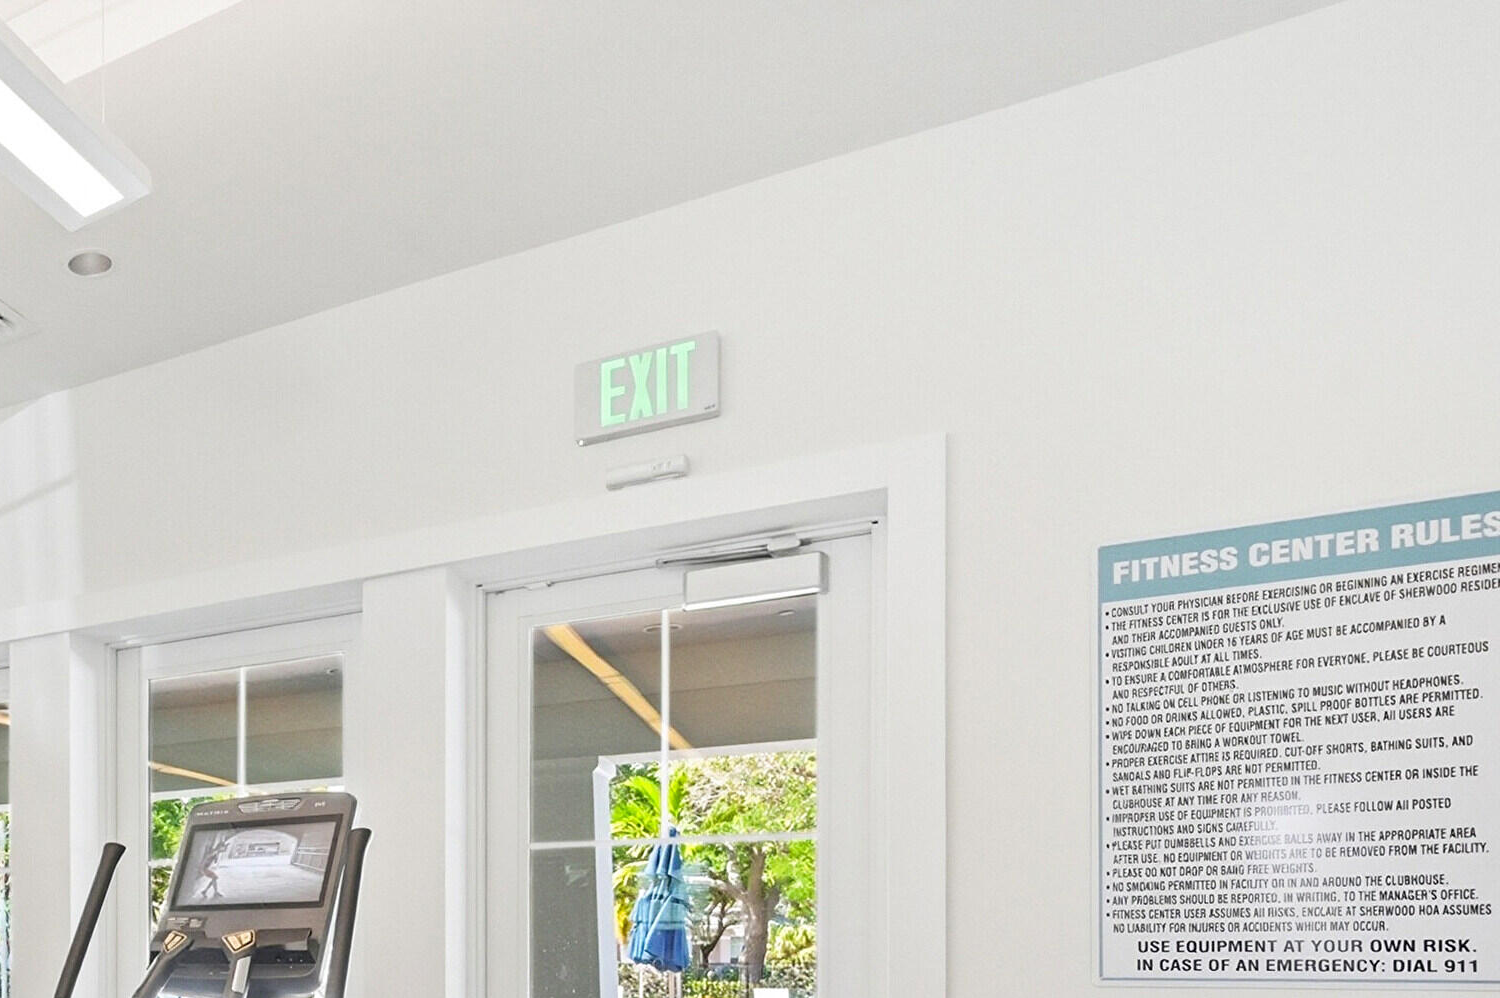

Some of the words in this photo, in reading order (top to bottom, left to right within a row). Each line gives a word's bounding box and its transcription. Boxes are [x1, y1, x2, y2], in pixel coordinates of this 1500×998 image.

[601, 341, 695, 427] EXIT
[1113, 546, 1238, 584] FITNESS
[1249, 528, 1379, 567] CENTER
[1391, 511, 1500, 549] RULES
[1177, 595, 1223, 610] PHYSICIAN
[1318, 582, 1332, 593] OR
[1335, 575, 1387, 592] BEGINNING
[1390, 573, 1404, 585] AN
[1406, 567, 1454, 583] EXERCISE
[1165, 612, 1198, 625] CENTER
[1201, 610, 1210, 621] IS
[1212, 608, 1230, 620] FOR
[1232, 606, 1248, 618] THE
[1302, 598, 1321, 610] USE
[1324, 596, 1336, 608] OF
[1338, 591, 1380, 606] ENCLAVE
[1383, 589, 1396, 601] OF
[1398, 582, 1457, 599] SHERWOOD
[1111, 633, 1129, 645] AND
[1131, 631, 1156, 643] THEIR
[1158, 623, 1220, 640] ACCOMPANIED
[1222, 619, 1257, 633] GUESTS
[1194, 637, 1224, 650] UNDER
[1238, 633, 1268, 646] YEARS
[1284, 629, 1304, 641] AGE
[1306, 626, 1332, 639] MUST
[1335, 624, 1347, 636] BE
[1349, 617, 1420, 634] ACCOMPANIED
[1422, 615, 1436, 627] BY
[1438, 614, 1446, 625] A
[1159, 671, 1166, 681] A
[1295, 657, 1315, 669] FOR
[1372, 648, 1409, 662] PLEASE
[1411, 647, 1424, 658] BE
[1426, 641, 1488, 657] COURTEOUS
[1171, 654, 1198, 666] ADULT
[1200, 653, 1211, 664] AT
[1212, 651, 1230, 662] ALL
[1112, 689, 1129, 700] AND
[1187, 682, 1198, 693] OF
[1177, 696, 1198, 708] CELL
[1200, 694, 1230, 706] PHONE
[1232, 692, 1245, 703] OR
[1247, 688, 1294, 702] LISTENING
[1297, 687, 1310, 698] TO
[1312, 684, 1343, 697] MUSIC
[1345, 680, 1390, 694] WITHOUT
[1111, 717, 1123, 727] NO
[1125, 715, 1148, 726] FOOD
[1150, 713, 1163, 724] OR
[1291, 701, 1317, 713] SPILL
[1319, 698, 1352, 711] PROOF
[1354, 695, 1396, 708] BOTTLES
[1398, 693, 1418, 705] ARE
[1134, 727, 1161, 739] DOWN
[1188, 724, 1212, 735] PIECE
[1228, 718, 1280, 732] EQUIPMENT
[1282, 717, 1302, 728] FOR
[1304, 715, 1322, 727] THE
[1324, 713, 1348, 725] NEXT
[1398, 707, 1432, 720] USERS
[1434, 705, 1454, 717] ARE
[1147, 754, 1188, 766] EXERCISE
[1284, 745, 1323, 757] CUT-OFF
[1370, 739, 1412, 752] BATHING
[1451, 735, 1473, 747] AND
[1171, 740, 1182, 750] TO
[1214, 737, 1220, 747] A
[1112, 785, 1130, 796] WET
[1170, 781, 1195, 792] SUITS
[1198, 780, 1215, 791] ARE
[1217, 779, 1234, 790] NOT
[1290, 775, 1300, 786] IN
[1302, 774, 1321, 785] THE
[1323, 772, 1362, 784] FITNESS
[1364, 770, 1402, 782] CENTER
[1404, 769, 1419, 780] OR
[1422, 766, 1456, 779] INSIDE
[1459, 765, 1478, 777] THE
[1152, 769, 1170, 779] AND
[1224, 764, 1242, 775] ARE
[1244, 763, 1263, 774] NOT
[1158, 810, 1174, 821] USE
[1316, 802, 1351, 814] PLEASE
[1353, 800, 1393, 812] FOLLOW
[1411, 797, 1451, 810] POSTED
[1163, 796, 1175, 807] AT
[1196, 794, 1218, 805] TIME
[1220, 793, 1238, 804] FOR
[1144, 839, 1162, 849] PUT
[1218, 836, 1236, 847] AND
[1345, 832, 1355, 842] IN
[1358, 831, 1376, 842] THE
[1378, 828, 1446, 841] APPROPRIATE
[1449, 827, 1476, 839] AREA
[1163, 852, 1176, 863] NO
[1324, 847, 1336, 858] BE
[1339, 845, 1385, 857] REMOVED
[1388, 844, 1417, 856] FROM
[1420, 844, 1439, 855] THE
[1112, 867, 1143, 878] PLEASE
[1205, 865, 1218, 875] OR
[1168, 880, 1216, 890] PERMITTED
[1322, 876, 1362, 887] AROUND
[1364, 876, 1382, 886] THE
[1179, 894, 1215, 904] SHOULD
[1217, 893, 1228, 904] BE
[1343, 891, 1356, 902] TO
[1358, 891, 1376, 901] THE
[1378, 890, 1437, 901] MANAGER'S
[1148, 908, 1181, 919] CENTER
[1183, 908, 1206, 918] USER
[1208, 907, 1251, 918] ASSUMES
[1345, 906, 1356, 916] AT
[1358, 905, 1415, 916] SHERWOOD
[1418, 905, 1440, 916] HOA
[1442, 904, 1492, 915] ASSUMES
[1168, 922, 1186, 932] FOR
[1294, 921, 1327, 932] WHICH
[1329, 921, 1350, 931] MAY
[1137, 940, 1170, 952] USE
[1176, 940, 1277, 952] EQUIPMENT
[1283, 940, 1304, 952] AT
[1310, 940, 1362, 952] YOUR
[1370, 939, 1415, 952] OWN
[1423, 939, 1476, 952] RISK.
[1136, 959, 1153, 970] IN
[1159, 959, 1202, 970] CASE
[1208, 959, 1230, 970] OF
[1235, 959, 1259, 971] AN
[1266, 959, 1385, 972] EMERGENCY:
[1392, 960, 1438, 972] DIAL
[1444, 960, 1477, 972] 911
